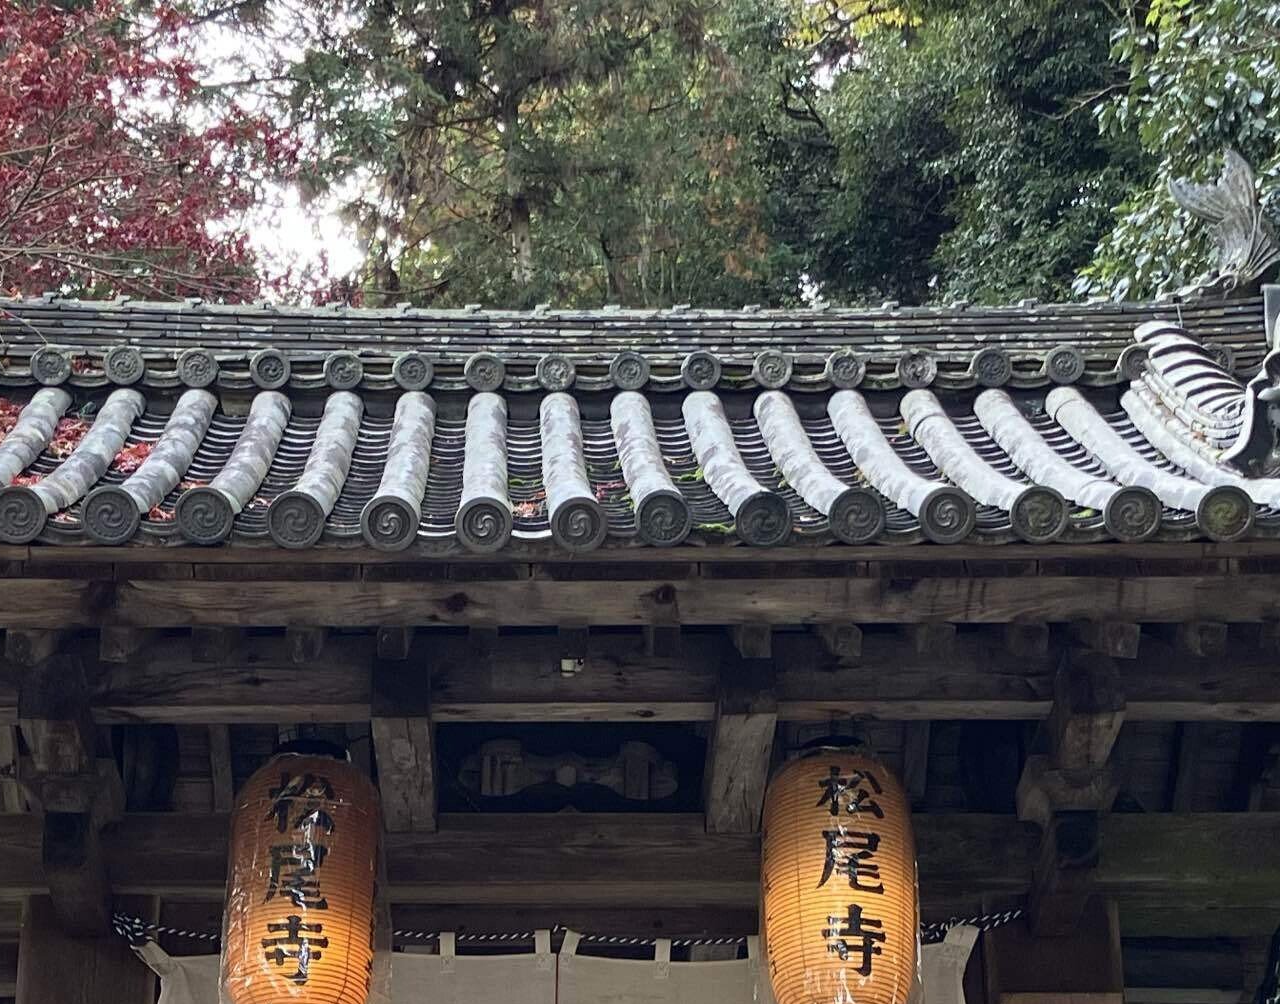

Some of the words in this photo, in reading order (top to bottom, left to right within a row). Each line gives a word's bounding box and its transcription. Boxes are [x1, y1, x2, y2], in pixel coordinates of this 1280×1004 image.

[263, 771, 336, 987] 松尾寺
[816, 766, 887, 978] 松尾寺
